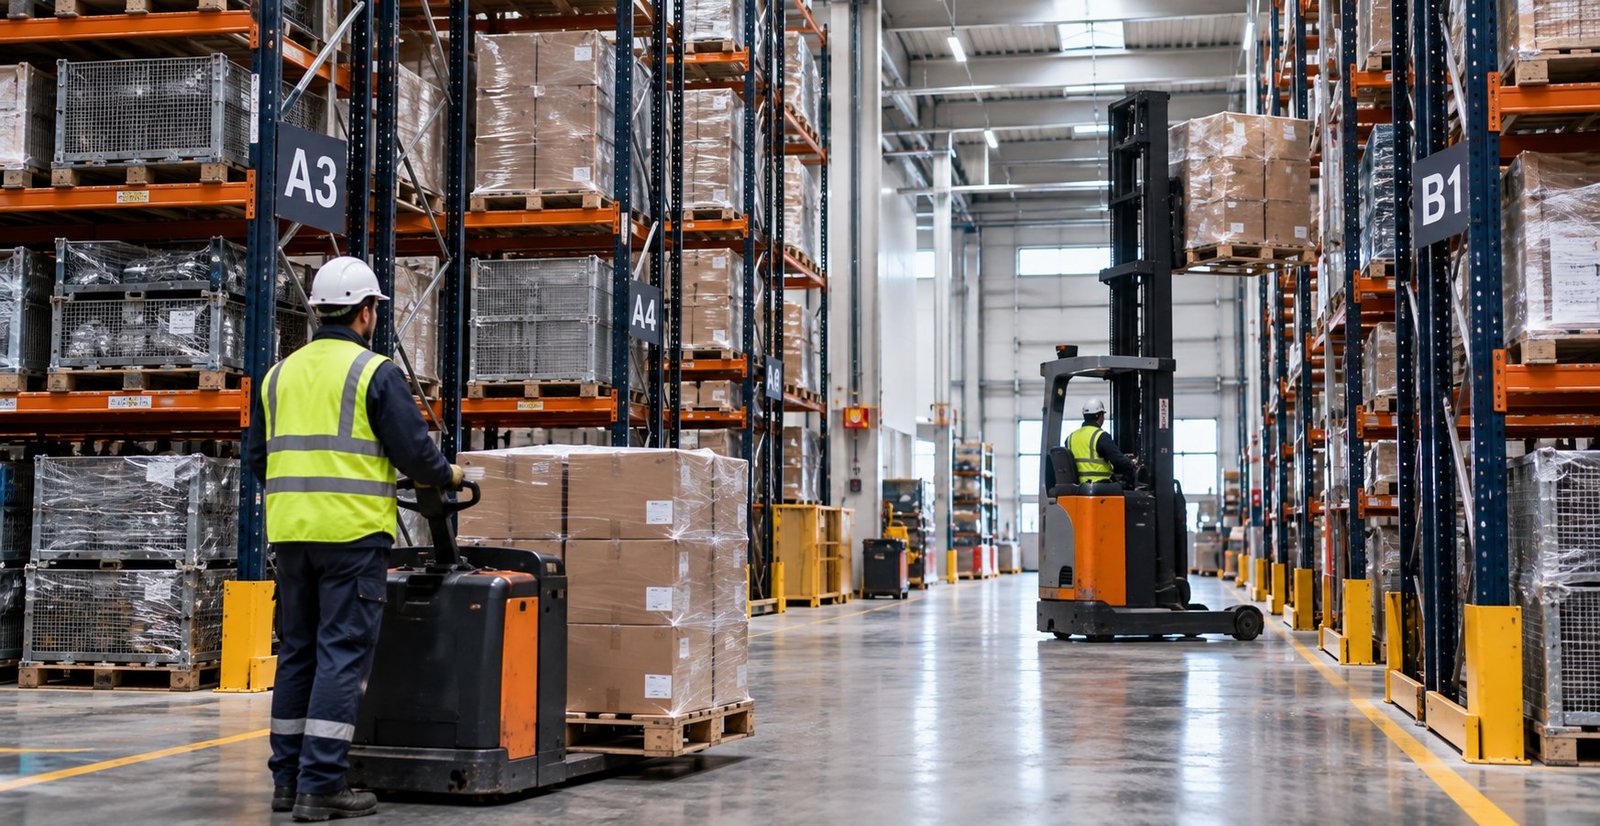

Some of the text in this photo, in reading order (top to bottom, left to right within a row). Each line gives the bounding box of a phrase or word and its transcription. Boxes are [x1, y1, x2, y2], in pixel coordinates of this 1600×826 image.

[284, 147, 337, 209] A3
[1422, 164, 1461, 226] B1
[632, 294, 656, 331] A4
